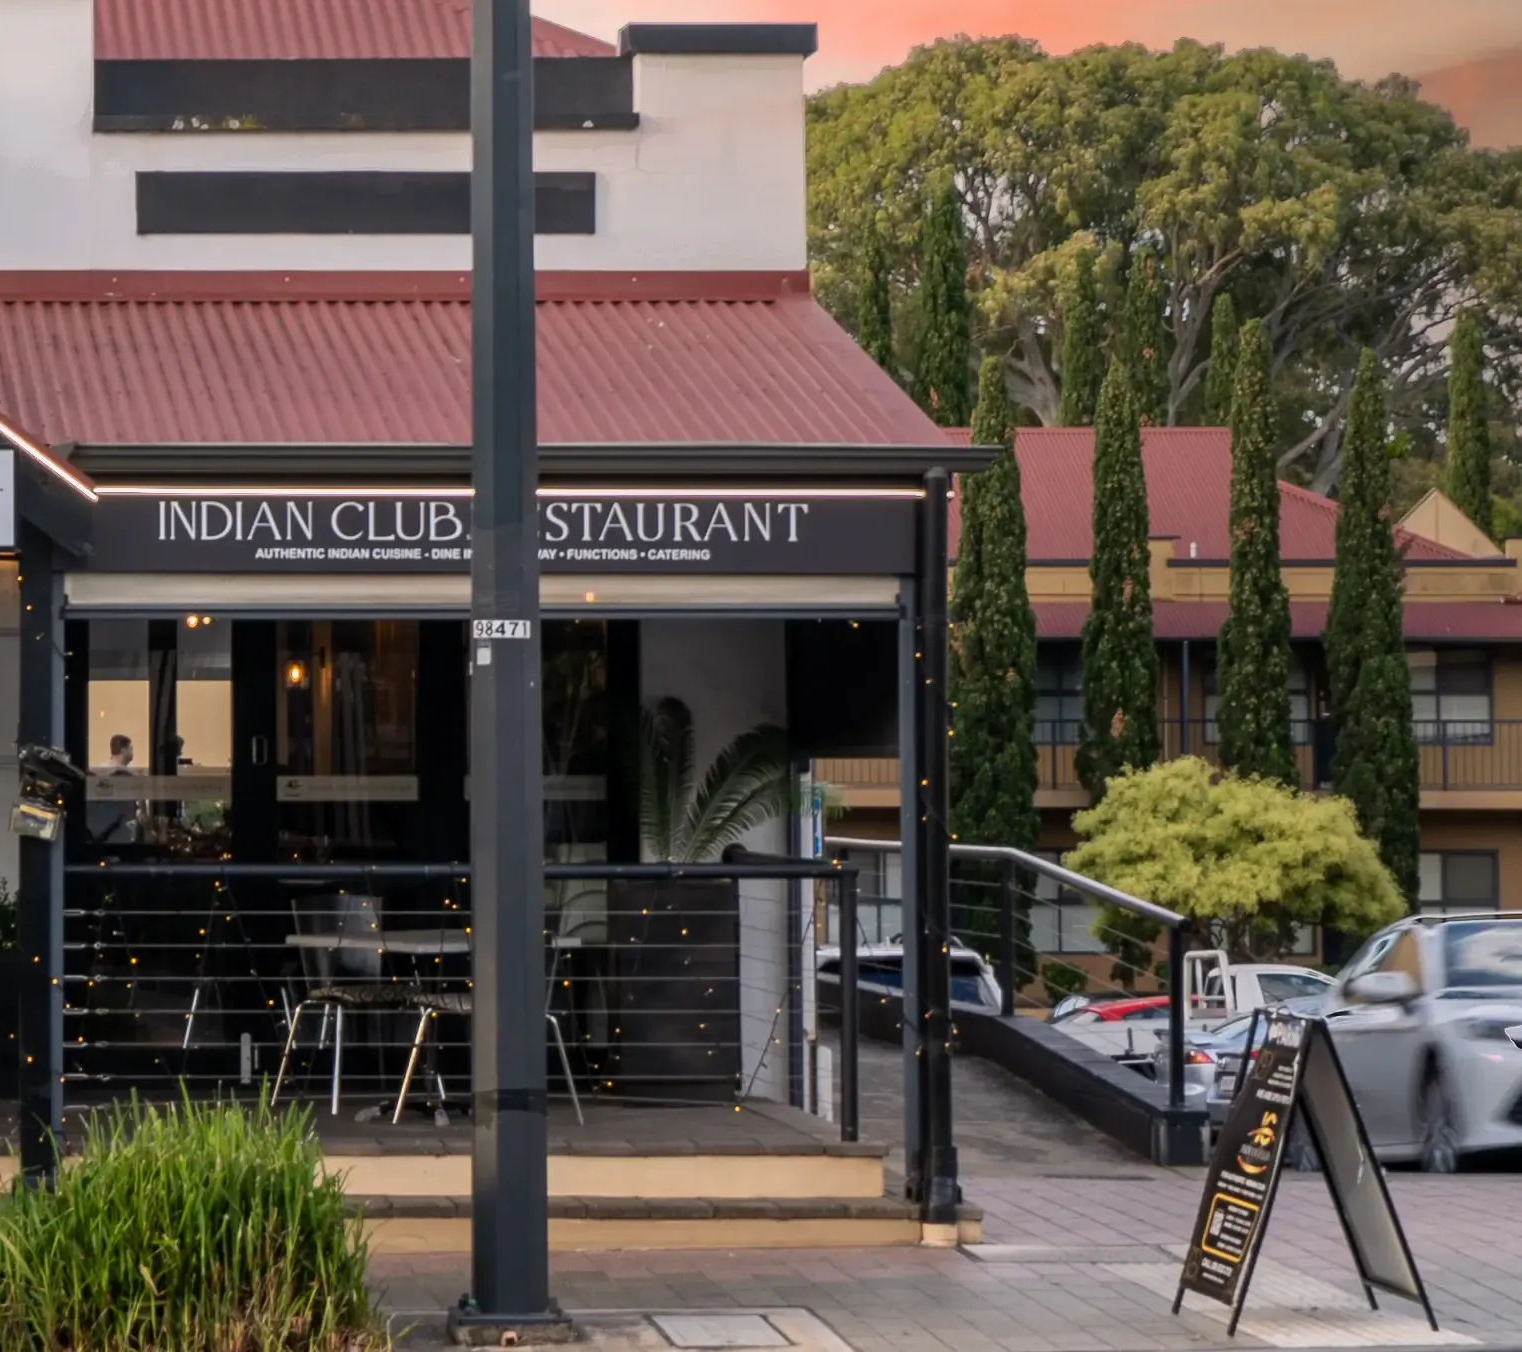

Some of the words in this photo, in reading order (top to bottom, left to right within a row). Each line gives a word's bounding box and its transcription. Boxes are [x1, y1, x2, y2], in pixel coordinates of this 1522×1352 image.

[158, 501, 313, 541] INDIAN
[330, 501, 464, 541] CLUB
[466, 501, 809, 542] STAURANT
[254, 548, 325, 560] AUTHENTIC
[328, 548, 369, 560] INDIAN
[372, 548, 422, 560] CUISINE
[431, 548, 461, 560] DINE
[566, 548, 638, 561] FUNCTIONS
[647, 548, 711, 561] CATERING
[475, 621, 527, 637] 98471
